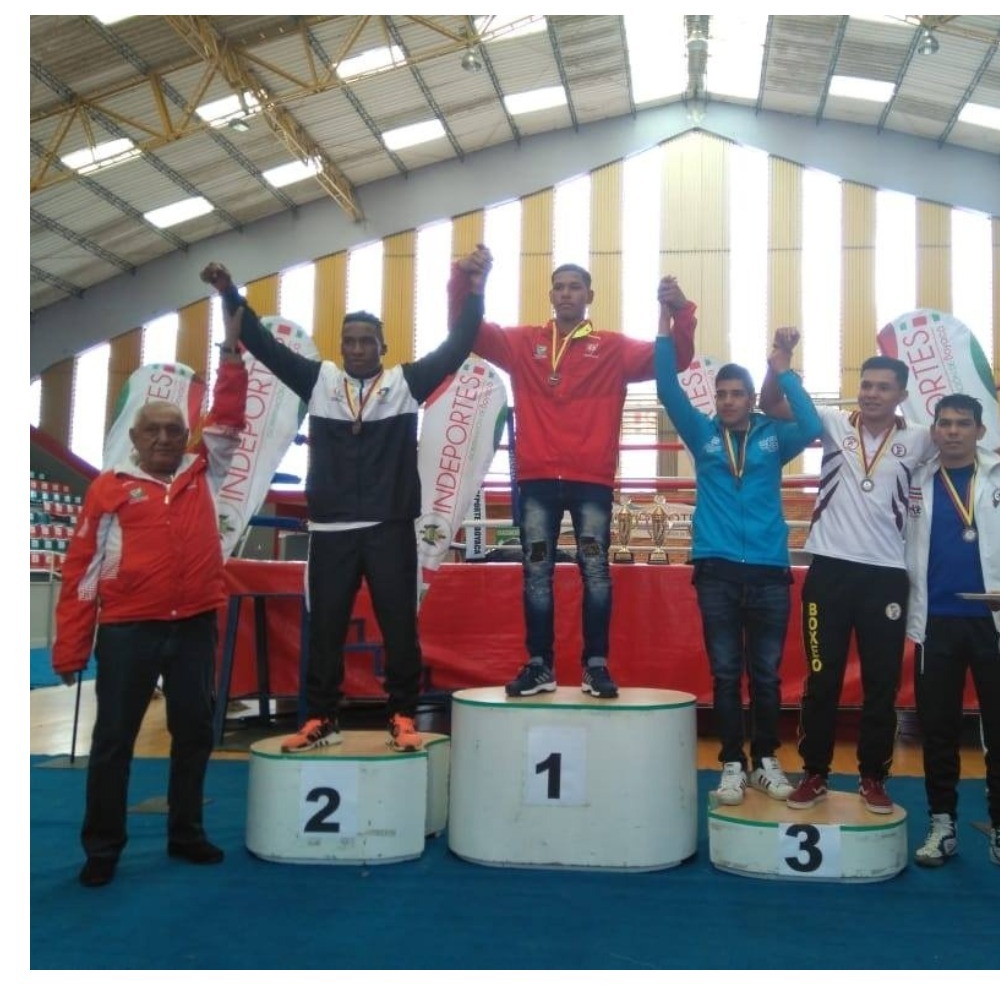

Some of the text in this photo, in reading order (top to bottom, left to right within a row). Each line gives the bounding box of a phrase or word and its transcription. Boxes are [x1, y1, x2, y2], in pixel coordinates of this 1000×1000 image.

[902, 330, 947, 417] ORTES
[220, 362, 273, 502] INDEPORT
[433, 375, 481, 514] INDEPORTES
[808, 603, 822, 672] BOXEO
[304, 787, 341, 834] 2
[535, 752, 563, 800] 1
[785, 824, 824, 872] 3
